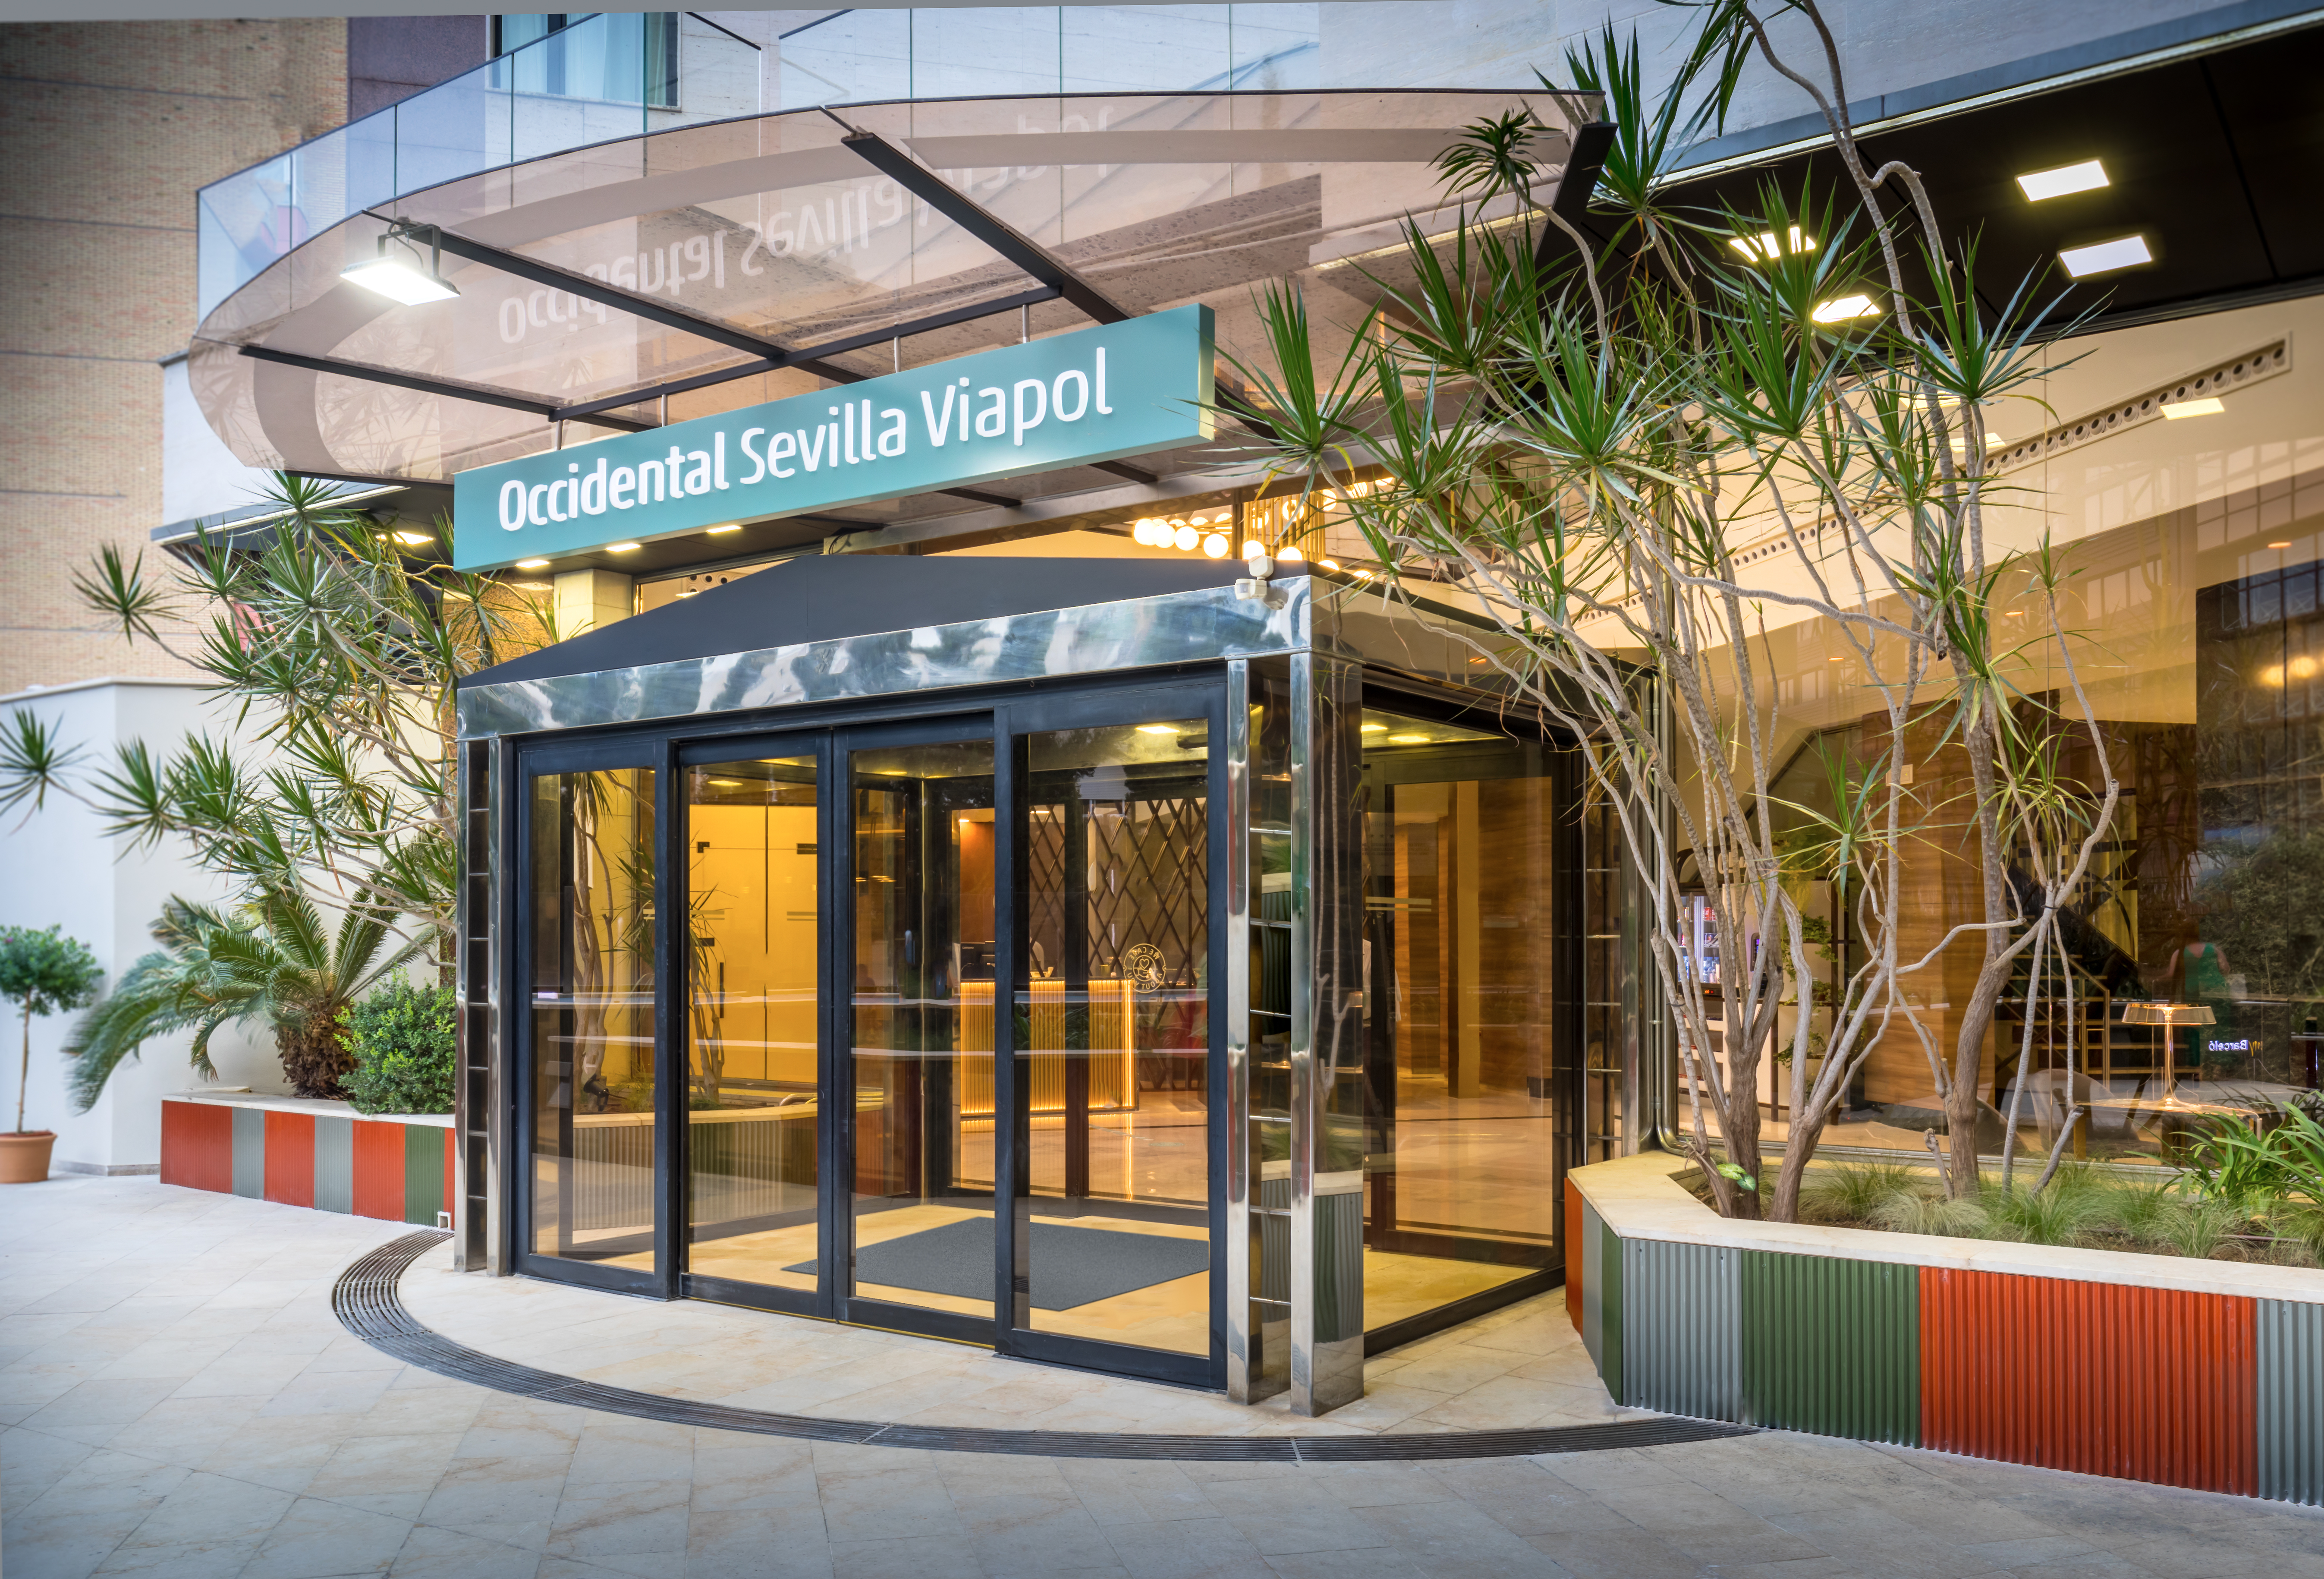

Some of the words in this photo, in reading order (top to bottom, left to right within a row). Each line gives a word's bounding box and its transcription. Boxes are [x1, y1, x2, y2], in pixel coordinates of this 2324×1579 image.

[499, 432, 730, 532] Occidental
[739, 399, 906, 485] Sevilla
[920, 346, 1113, 448] Viapol
